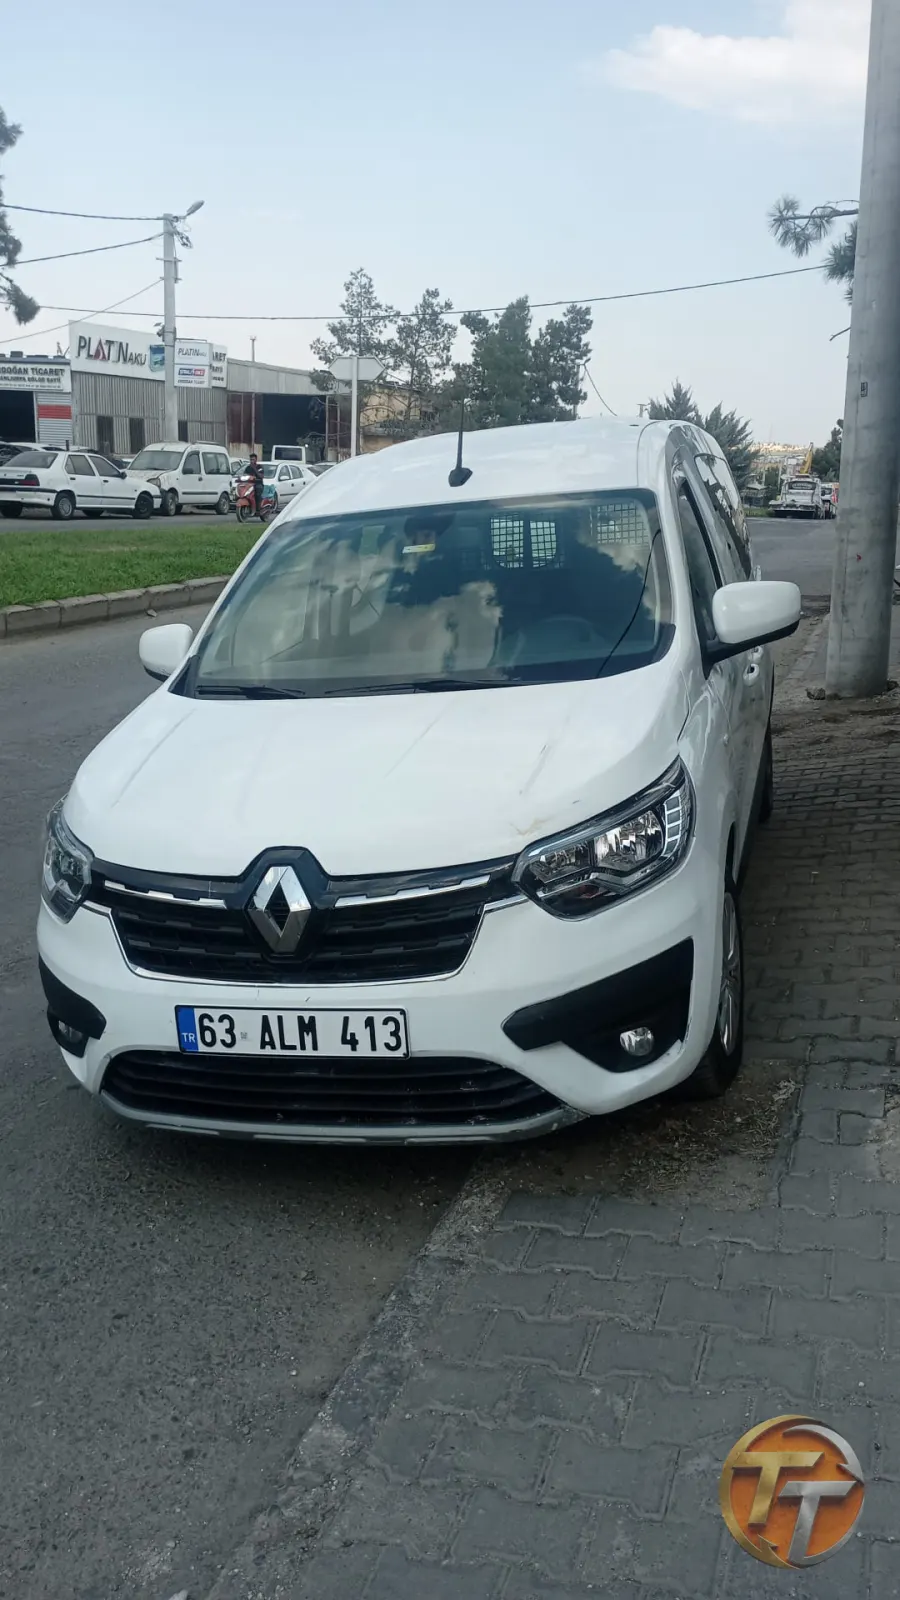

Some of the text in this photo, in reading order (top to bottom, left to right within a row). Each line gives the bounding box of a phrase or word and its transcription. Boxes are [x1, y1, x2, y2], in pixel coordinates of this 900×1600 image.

[181, 1032, 196, 1043] TR
[198, 1012, 402, 1052] 63 ALM 413
